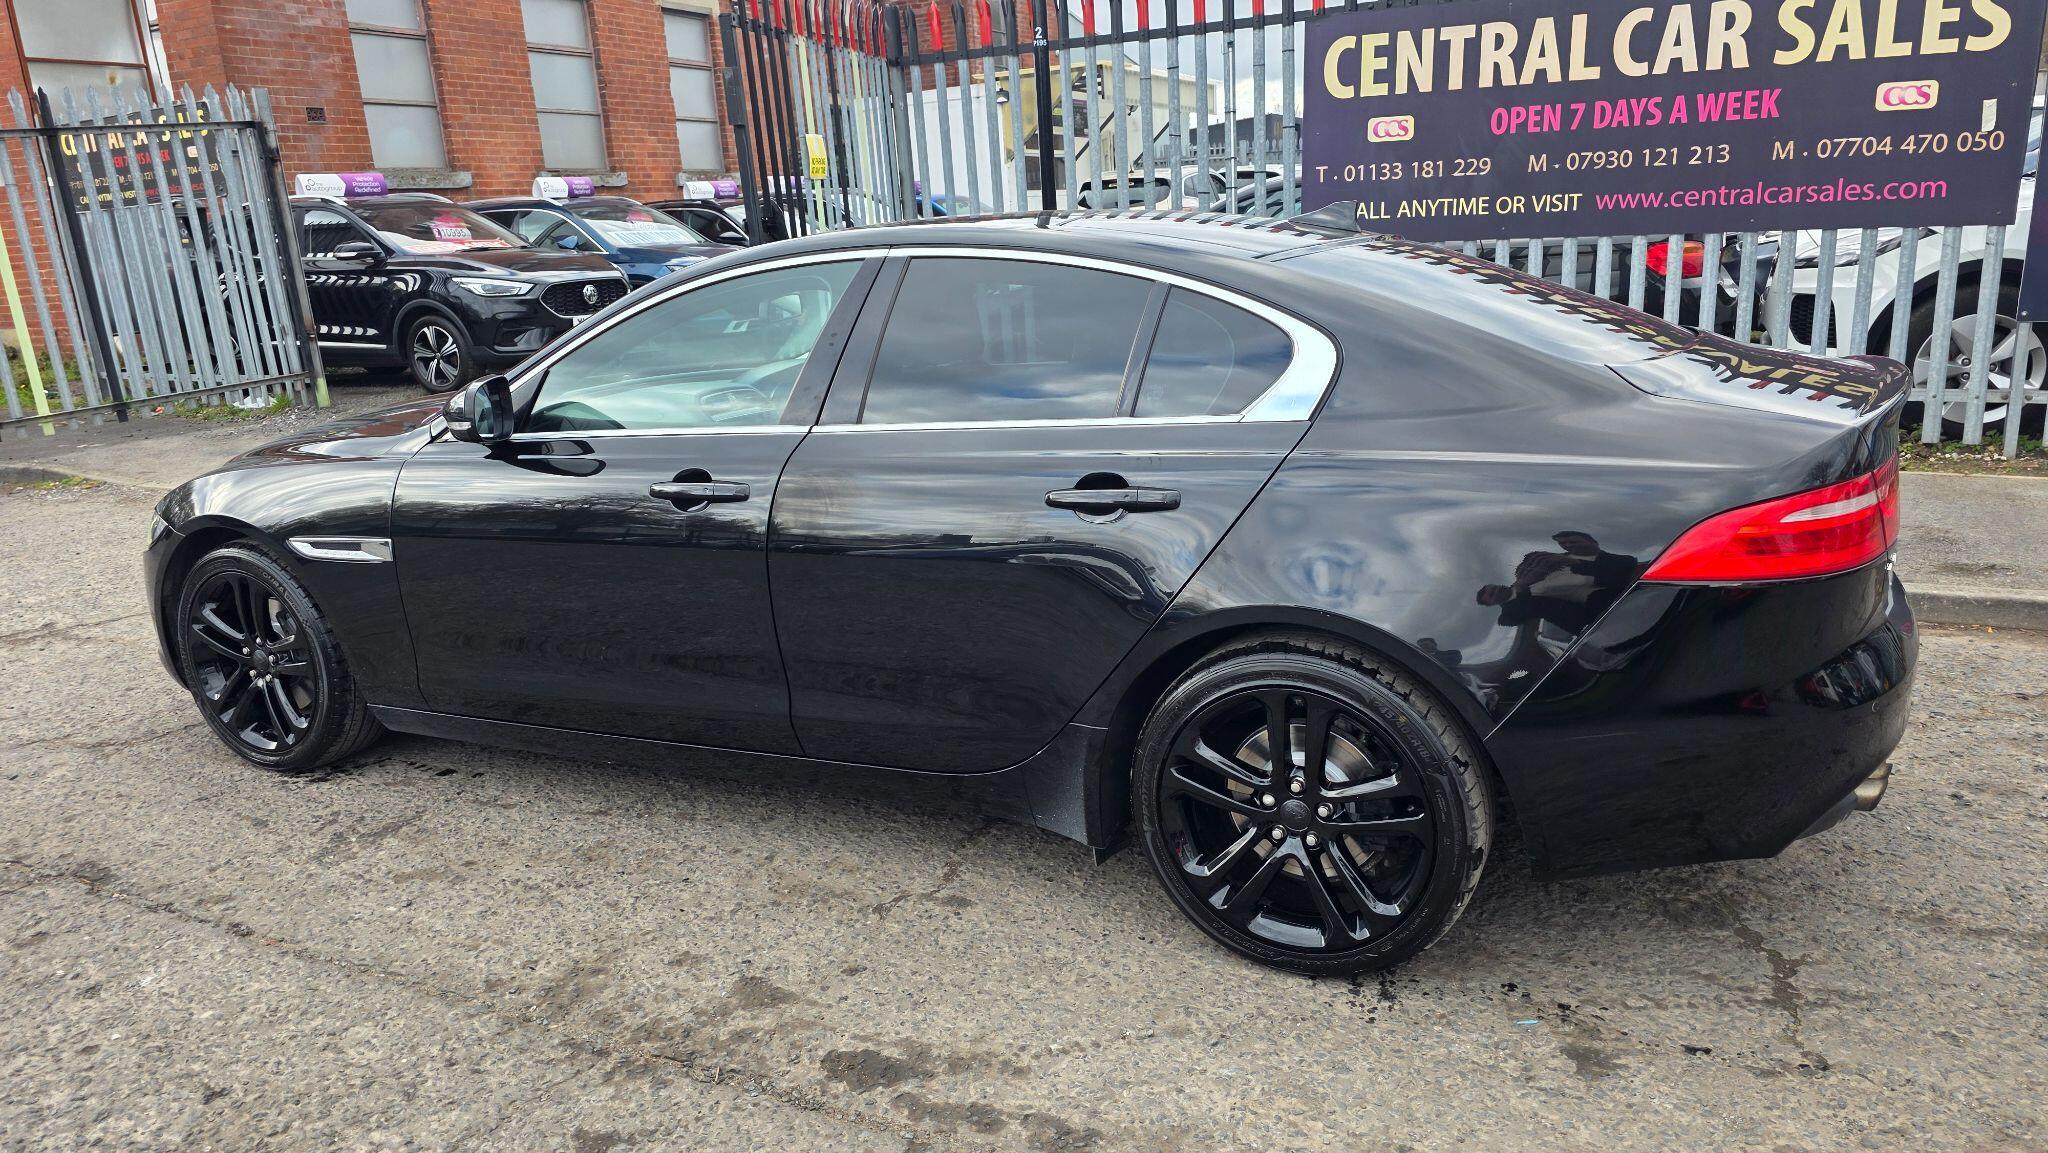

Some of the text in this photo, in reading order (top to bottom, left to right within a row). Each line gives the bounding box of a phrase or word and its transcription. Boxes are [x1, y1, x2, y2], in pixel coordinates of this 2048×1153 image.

[1324, 0, 2011, 99] CENTRAL CAR SALES
[1491, 89, 1781, 135] OPEN 7 DAYS A WEEK
[1527, 154, 1547, 173] M
[1567, 150, 1633, 170] 07930
[1643, 148, 1678, 167] 121
[1688, 144, 1730, 165] 213
[1773, 141, 1795, 161] M
[1817, 136, 1893, 158] 07704
[1900, 134, 1949, 155] 470
[1957, 130, 2005, 153] 050
[1316, 166, 1328, 183] T
[1344, 163, 1403, 182] 01133
[1411, 161, 1444, 178] 181
[1451, 158, 1492, 177] 229
[1357, 193, 1584, 220] ALL ANYTIME OR VISIT
[1596, 178, 1948, 210] www.centralcarsales.com
